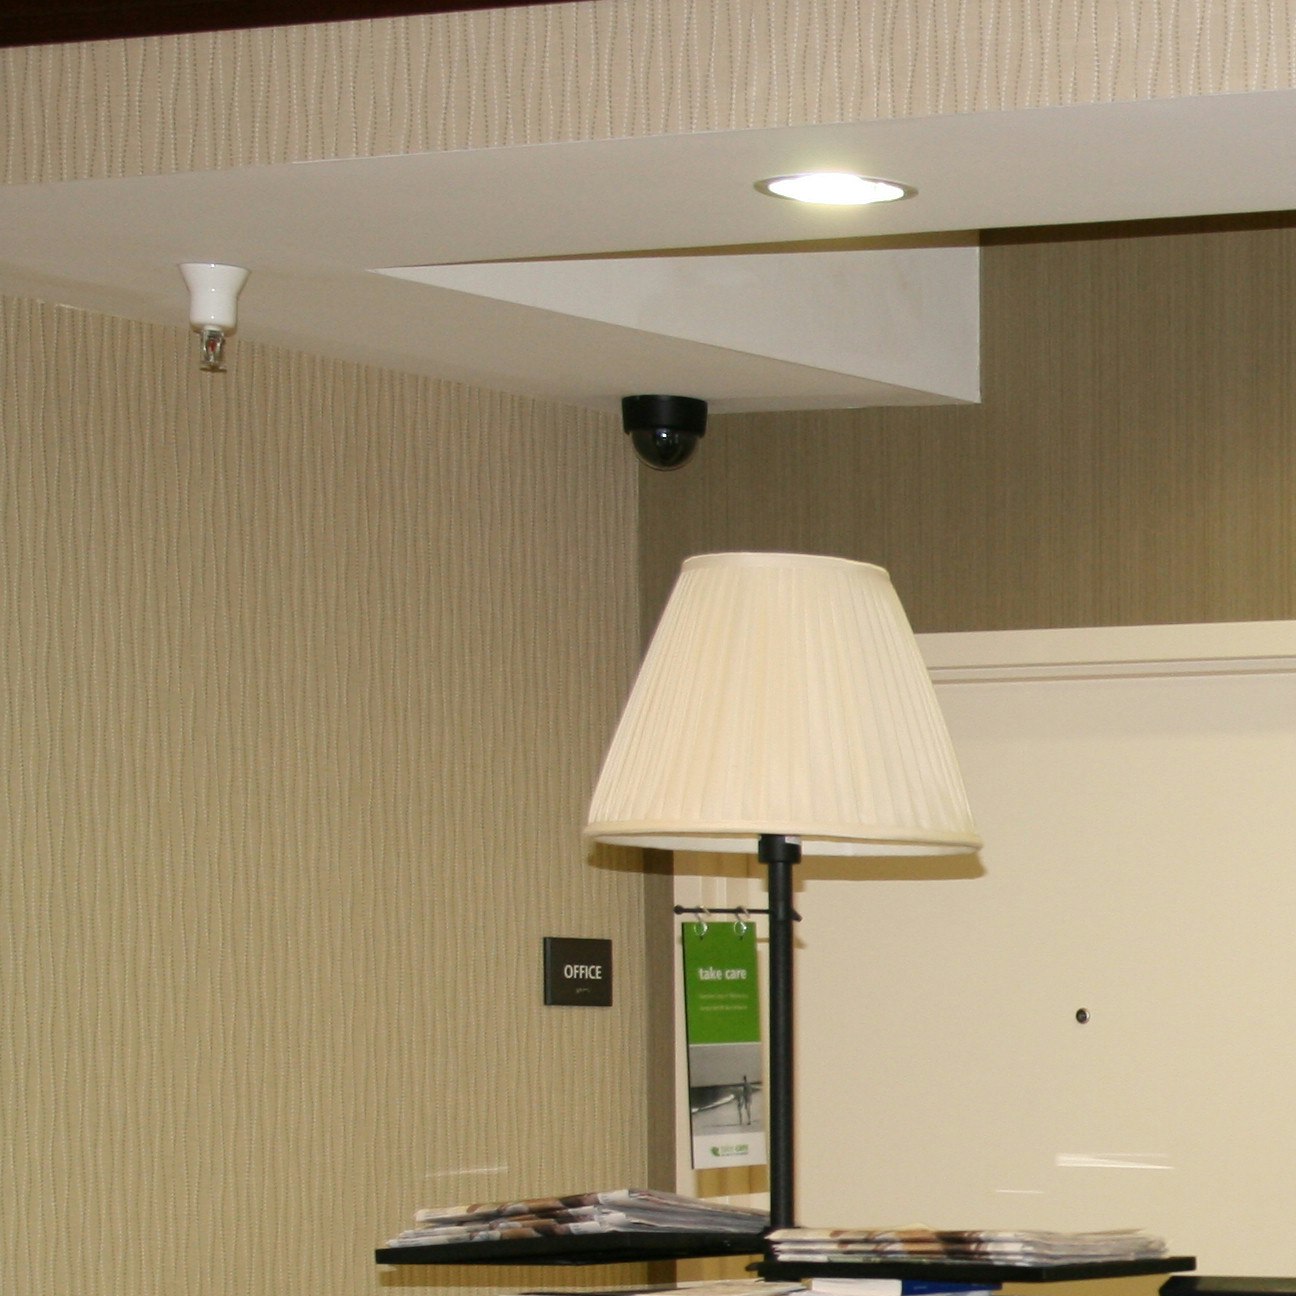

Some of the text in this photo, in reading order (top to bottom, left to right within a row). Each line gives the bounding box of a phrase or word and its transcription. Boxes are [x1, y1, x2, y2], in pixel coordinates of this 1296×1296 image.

[563, 964, 603, 980] OFFICE
[698, 966, 748, 981] take care
